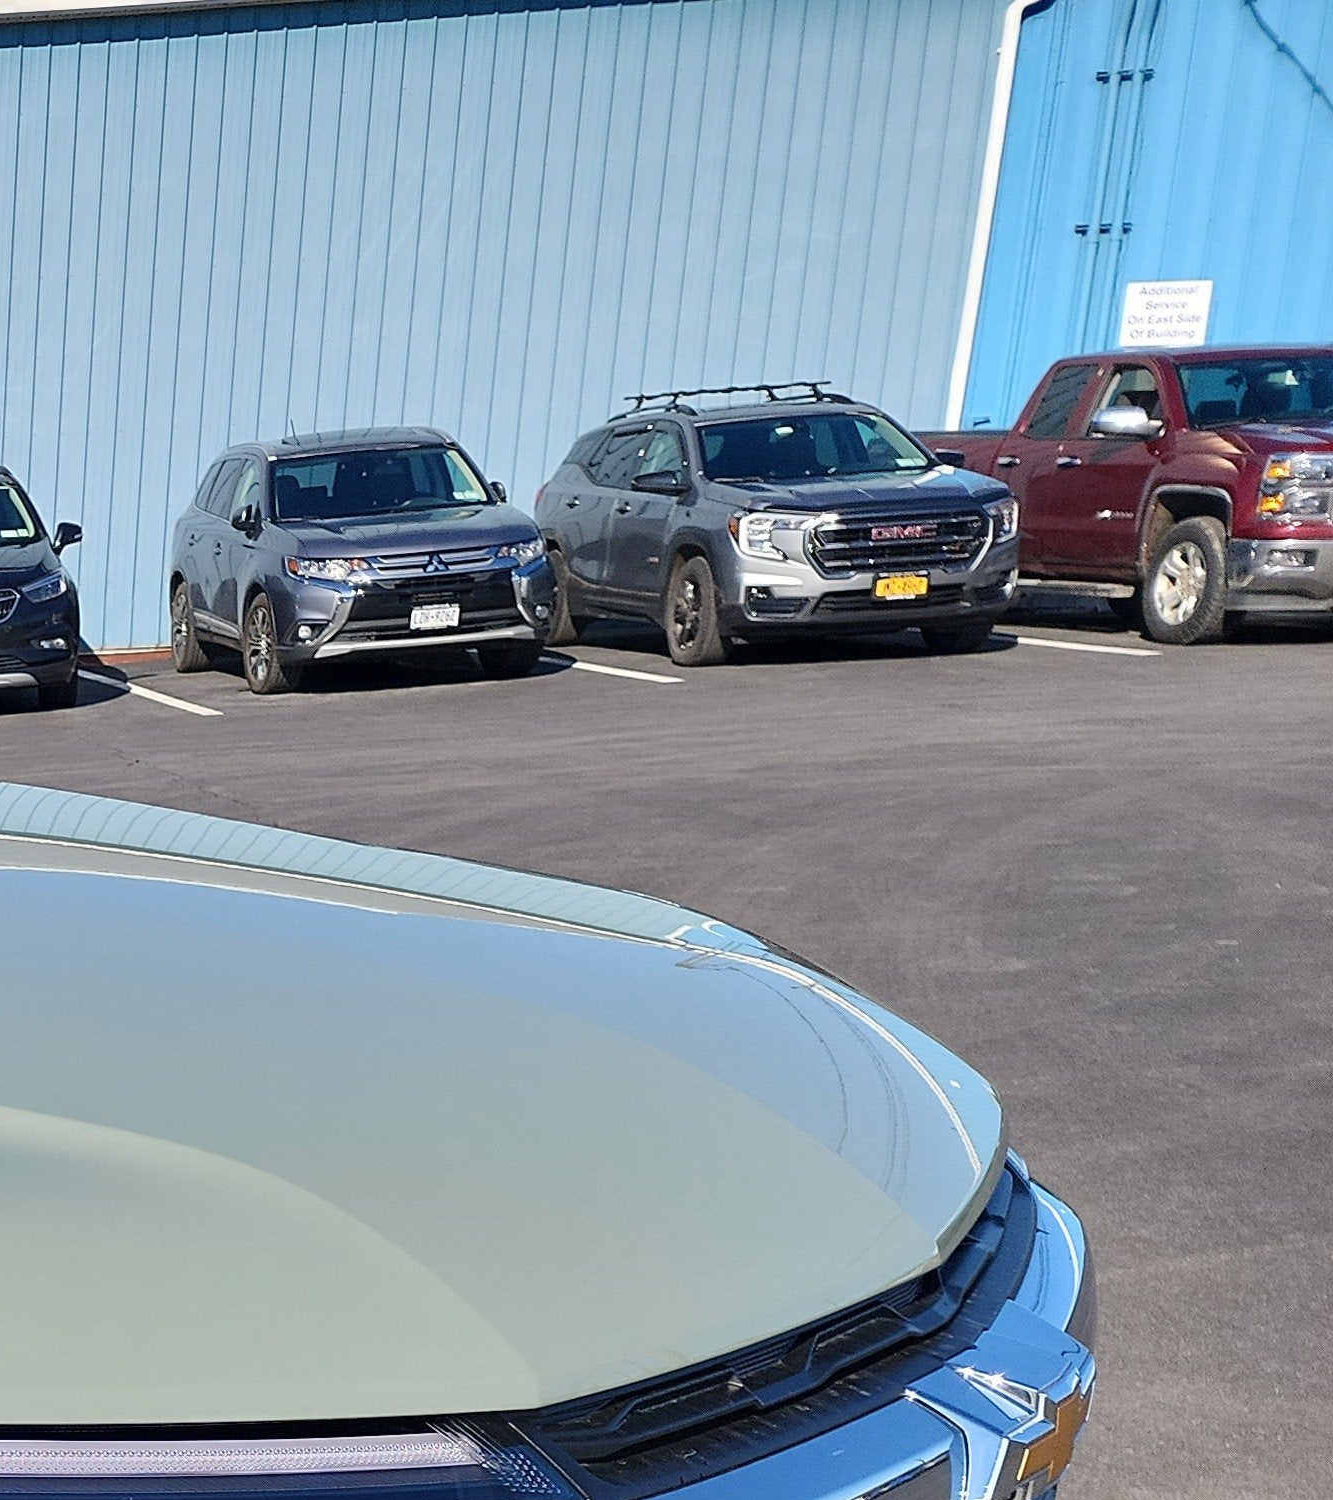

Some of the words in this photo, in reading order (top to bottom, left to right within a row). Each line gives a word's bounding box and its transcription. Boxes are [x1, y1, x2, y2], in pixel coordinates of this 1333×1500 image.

[1139, 285, 1199, 295] Additional
[1145, 300, 1188, 310] Service
[1127, 314, 1144, 325] On
[1176, 313, 1202, 323] Side
[1147, 329, 1195, 338] Building
[871, 523, 937, 541] GMC
